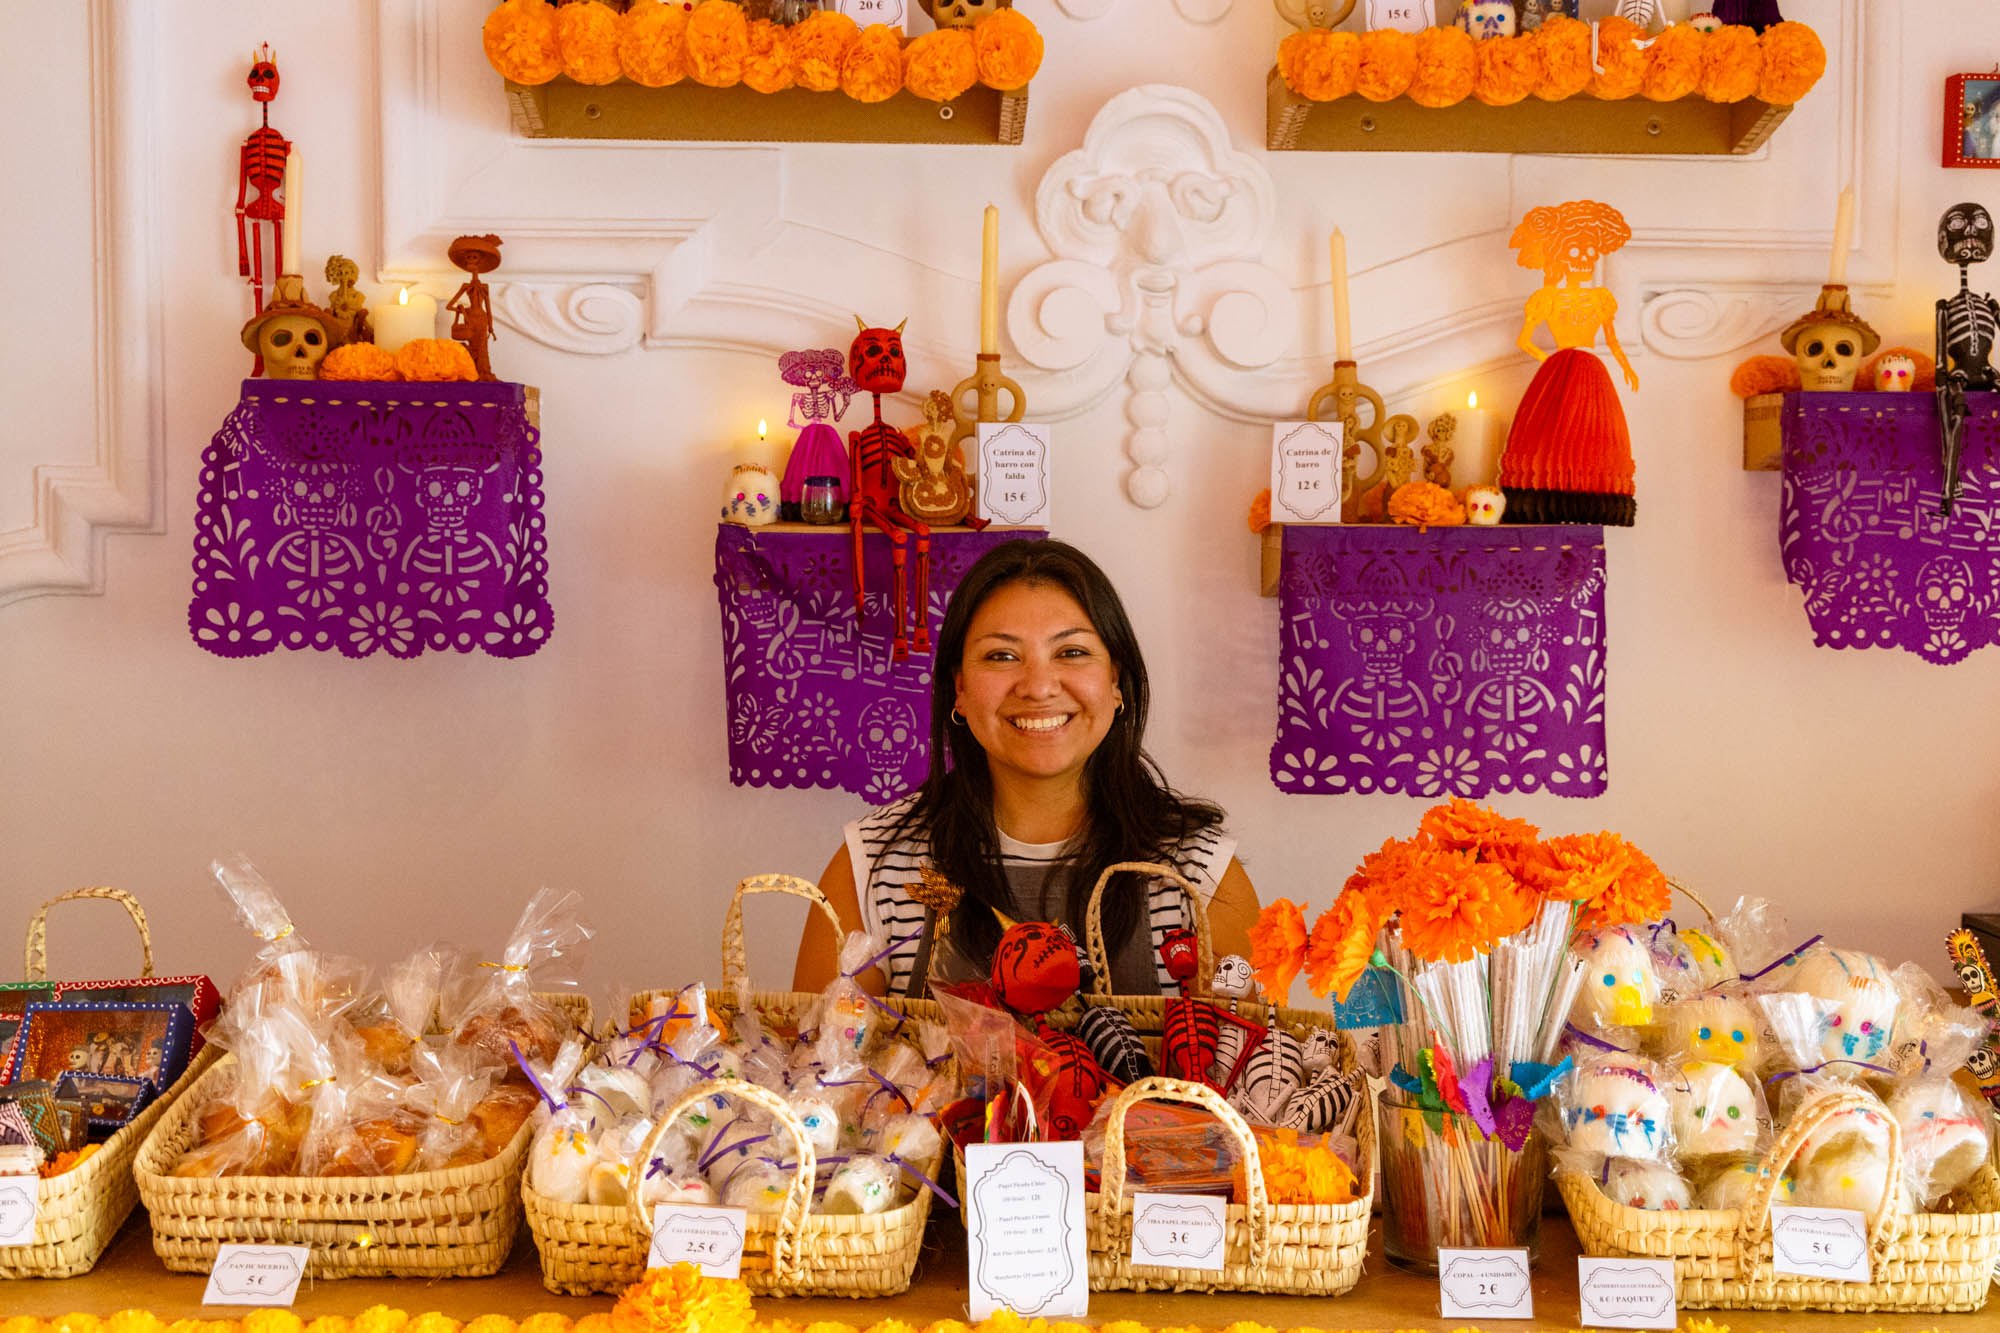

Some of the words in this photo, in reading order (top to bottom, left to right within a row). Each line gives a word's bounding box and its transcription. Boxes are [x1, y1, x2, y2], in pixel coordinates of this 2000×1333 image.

[859, 0, 873, 10] 20
[876, 0, 885, 10] €
[1388, 9, 1401, 19] 15
[1403, 9, 1411, 19] €
[993, 448, 1024, 456] Catrina
[1026, 448, 1037, 456] de
[1286, 448, 1319, 457] Catrina
[1321, 448, 1332, 456] de
[995, 461, 1018, 469] barro
[1020, 461, 1034, 469] con
[1295, 461, 1320, 469] barro
[1005, 472, 1025, 480] falda
[1298, 480, 1310, 490] 12
[1313, 480, 1321, 490] €
[1004, 492, 1017, 502] 15
[1019, 492, 1027, 502] €
[1169, 1231, 1177, 1243] 3
[1181, 1231, 1189, 1244] €
[686, 1241, 705, 1253] 2,5
[708, 1242, 718, 1254] €
[1812, 1242, 1820, 1253] 5
[1824, 1242, 1832, 1255] €
[246, 1275, 255, 1286] 5
[258, 1275, 266, 1286] €
[1479, 1283, 1486, 1295] 2
[1490, 1283, 1498, 1296] €
[1616, 1295, 1656, 1305] PAQUETE
